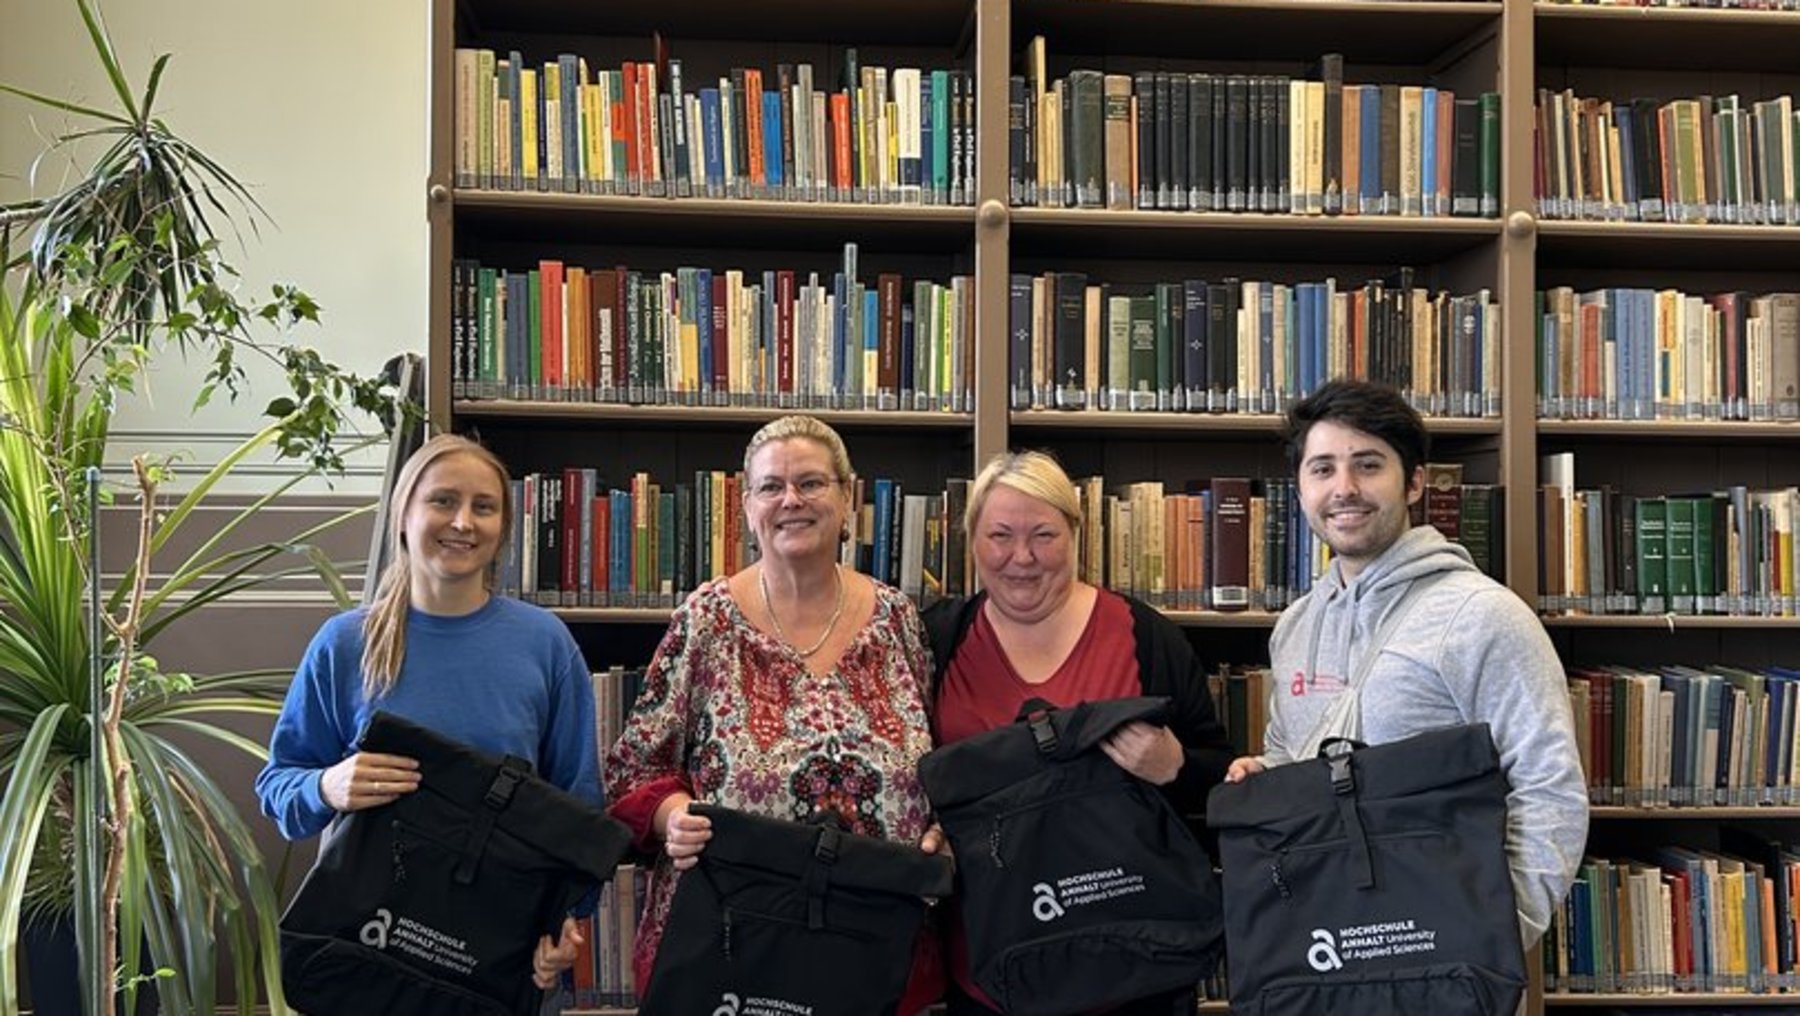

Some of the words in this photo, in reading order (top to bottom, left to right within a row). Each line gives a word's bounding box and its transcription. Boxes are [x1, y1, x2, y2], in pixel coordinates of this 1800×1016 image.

[1057, 867, 1123, 888] HOCHSCHULE
[1061, 882, 1099, 897] ANHALT
[1100, 875, 1143, 889] University
[1063, 898, 1072, 907] of
[1073, 891, 1107, 904] Applied
[1107, 884, 1145, 897] Sciences
[393, 927, 435, 948] ANHALT
[398, 917, 466, 950] HOCHSCHULE
[1339, 919, 1415, 938] HOCHSCHULE
[1341, 934, 1385, 949] ANHALT
[1386, 929, 1436, 944] University
[1341, 949, 1352, 960] of
[1353, 946, 1392, 960] Applied
[1393, 941, 1436, 955] Sciences
[745, 997, 813, 1015] HOCHSCHULE
